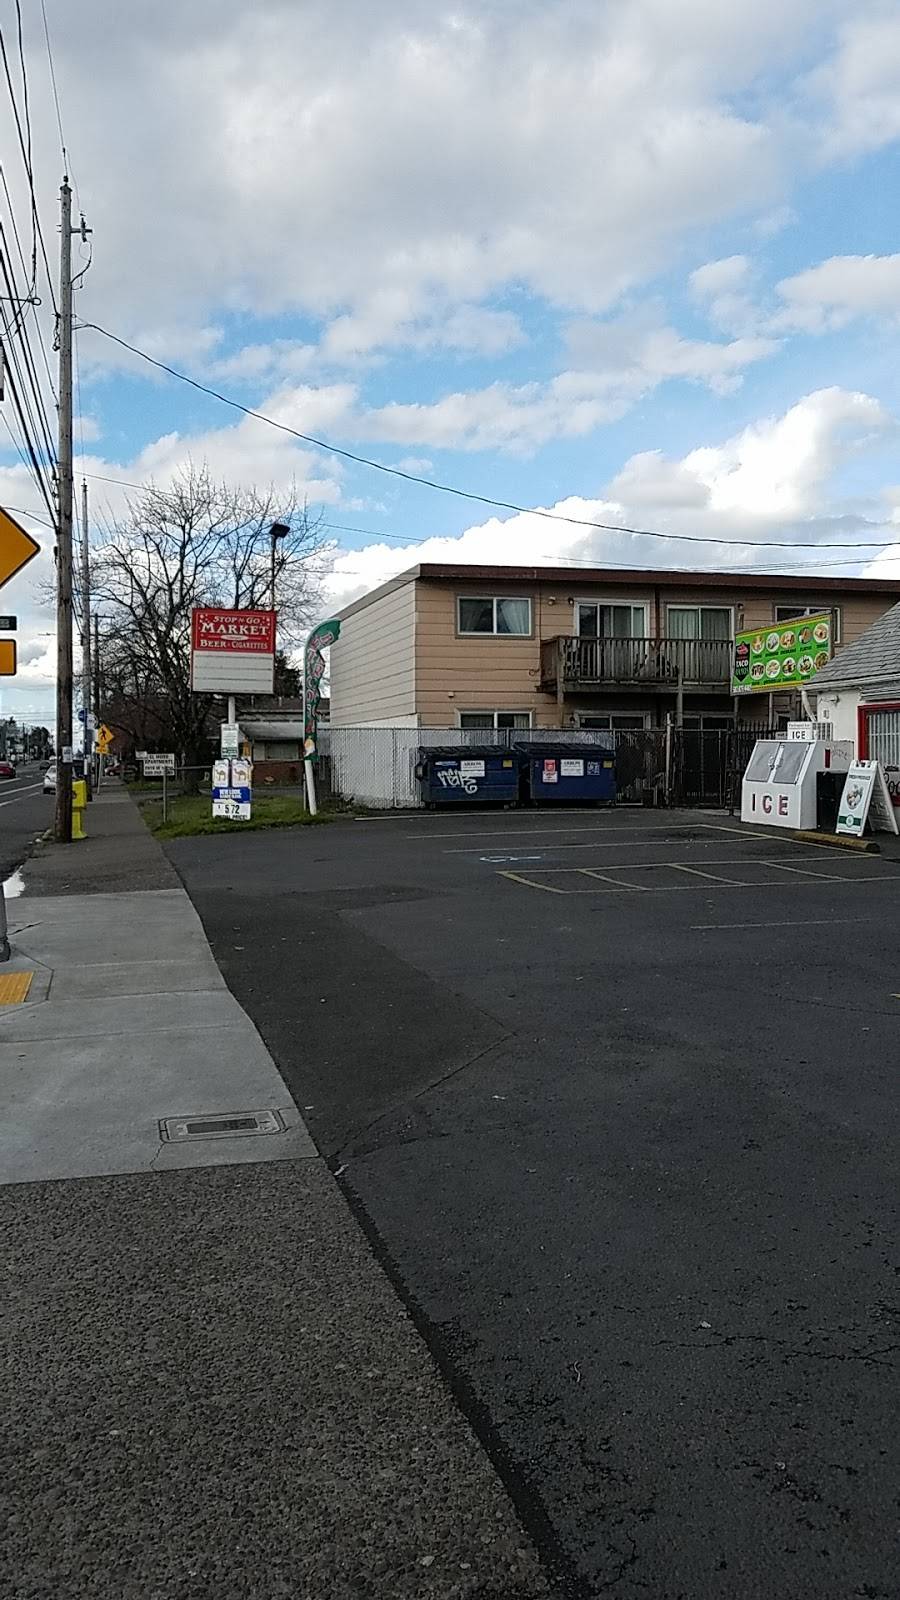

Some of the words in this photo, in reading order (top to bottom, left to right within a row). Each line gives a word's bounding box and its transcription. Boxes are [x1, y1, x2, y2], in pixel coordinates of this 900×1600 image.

[213, 616, 237, 624] STOP
[200, 622, 269, 635] MARKET
[200, 639, 227, 648] BEER
[231, 641, 268, 649] CIGARETTES
[792, 731, 805, 740] ICE
[751, 793, 789, 816] ICE
